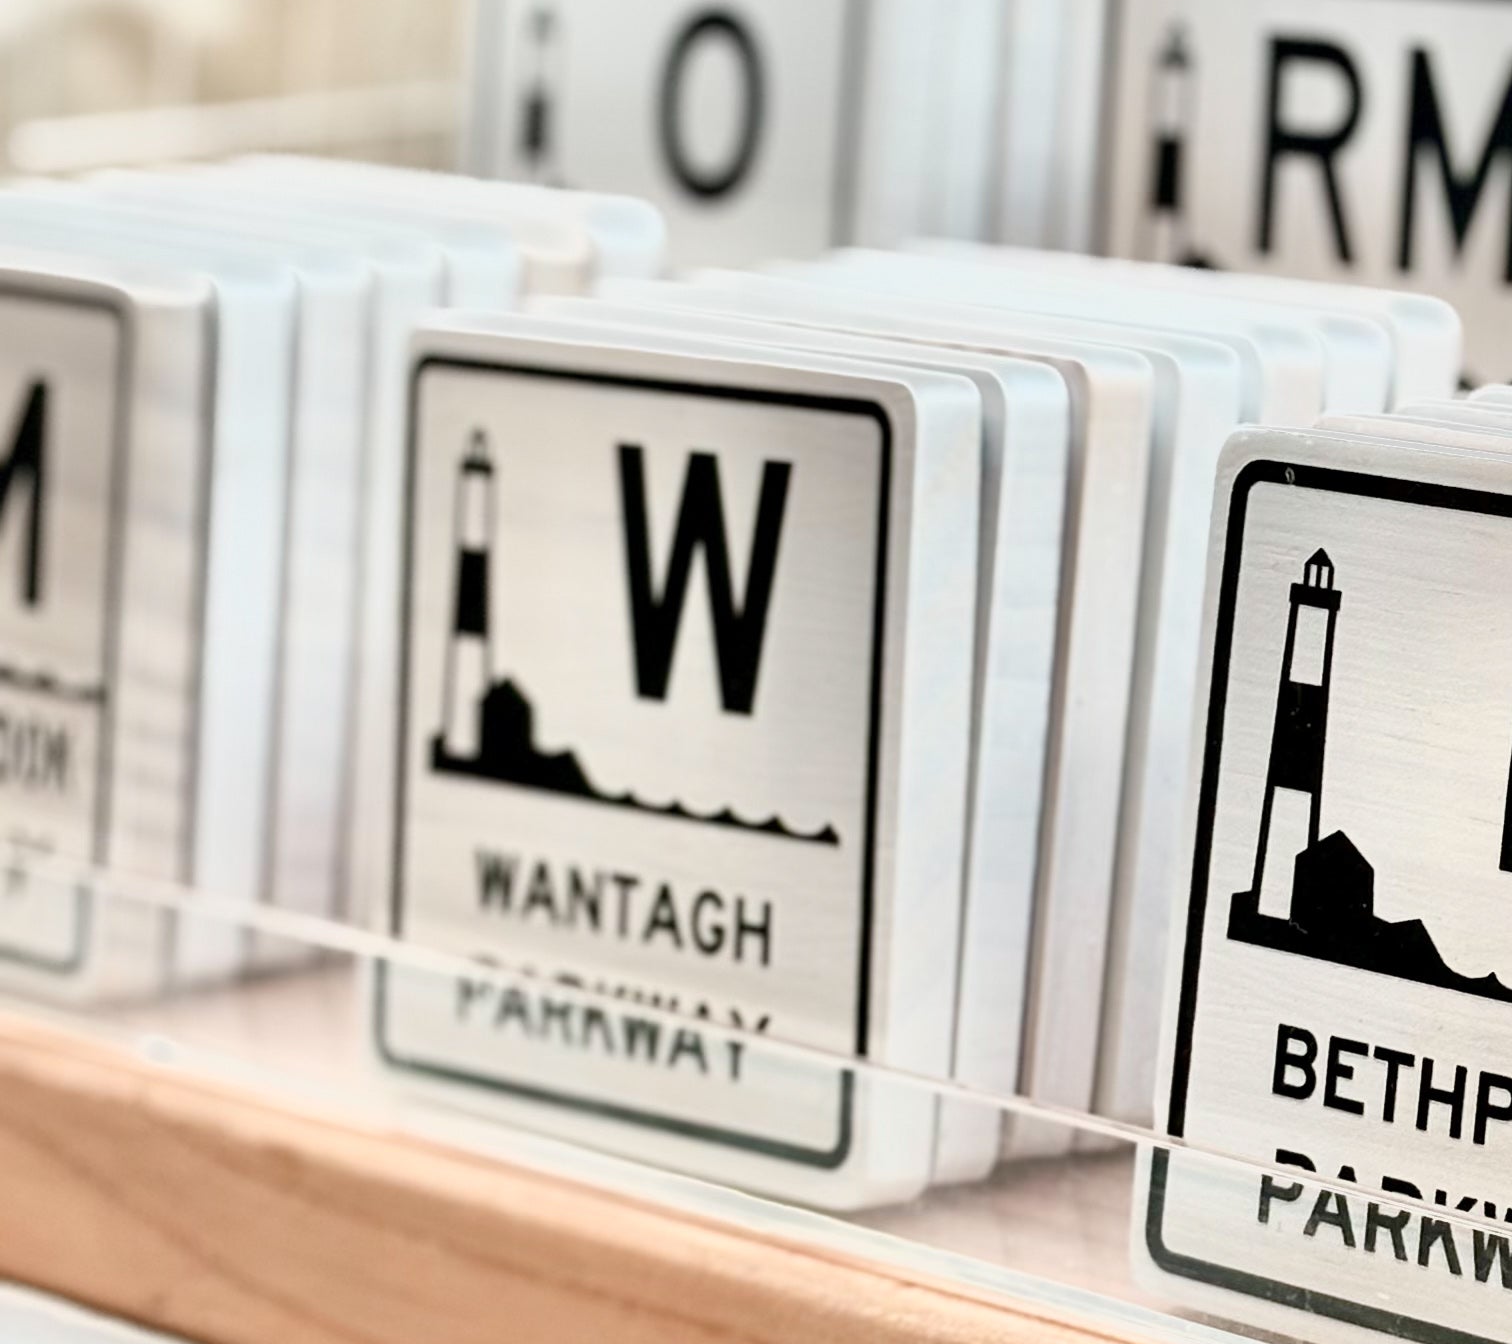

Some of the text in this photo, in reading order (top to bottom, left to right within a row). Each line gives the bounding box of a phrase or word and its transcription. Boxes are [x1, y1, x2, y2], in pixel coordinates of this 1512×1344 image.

[654, 3, 770, 211] O
[615, 441, 795, 718] W
[474, 845, 773, 968] WANTAGH
